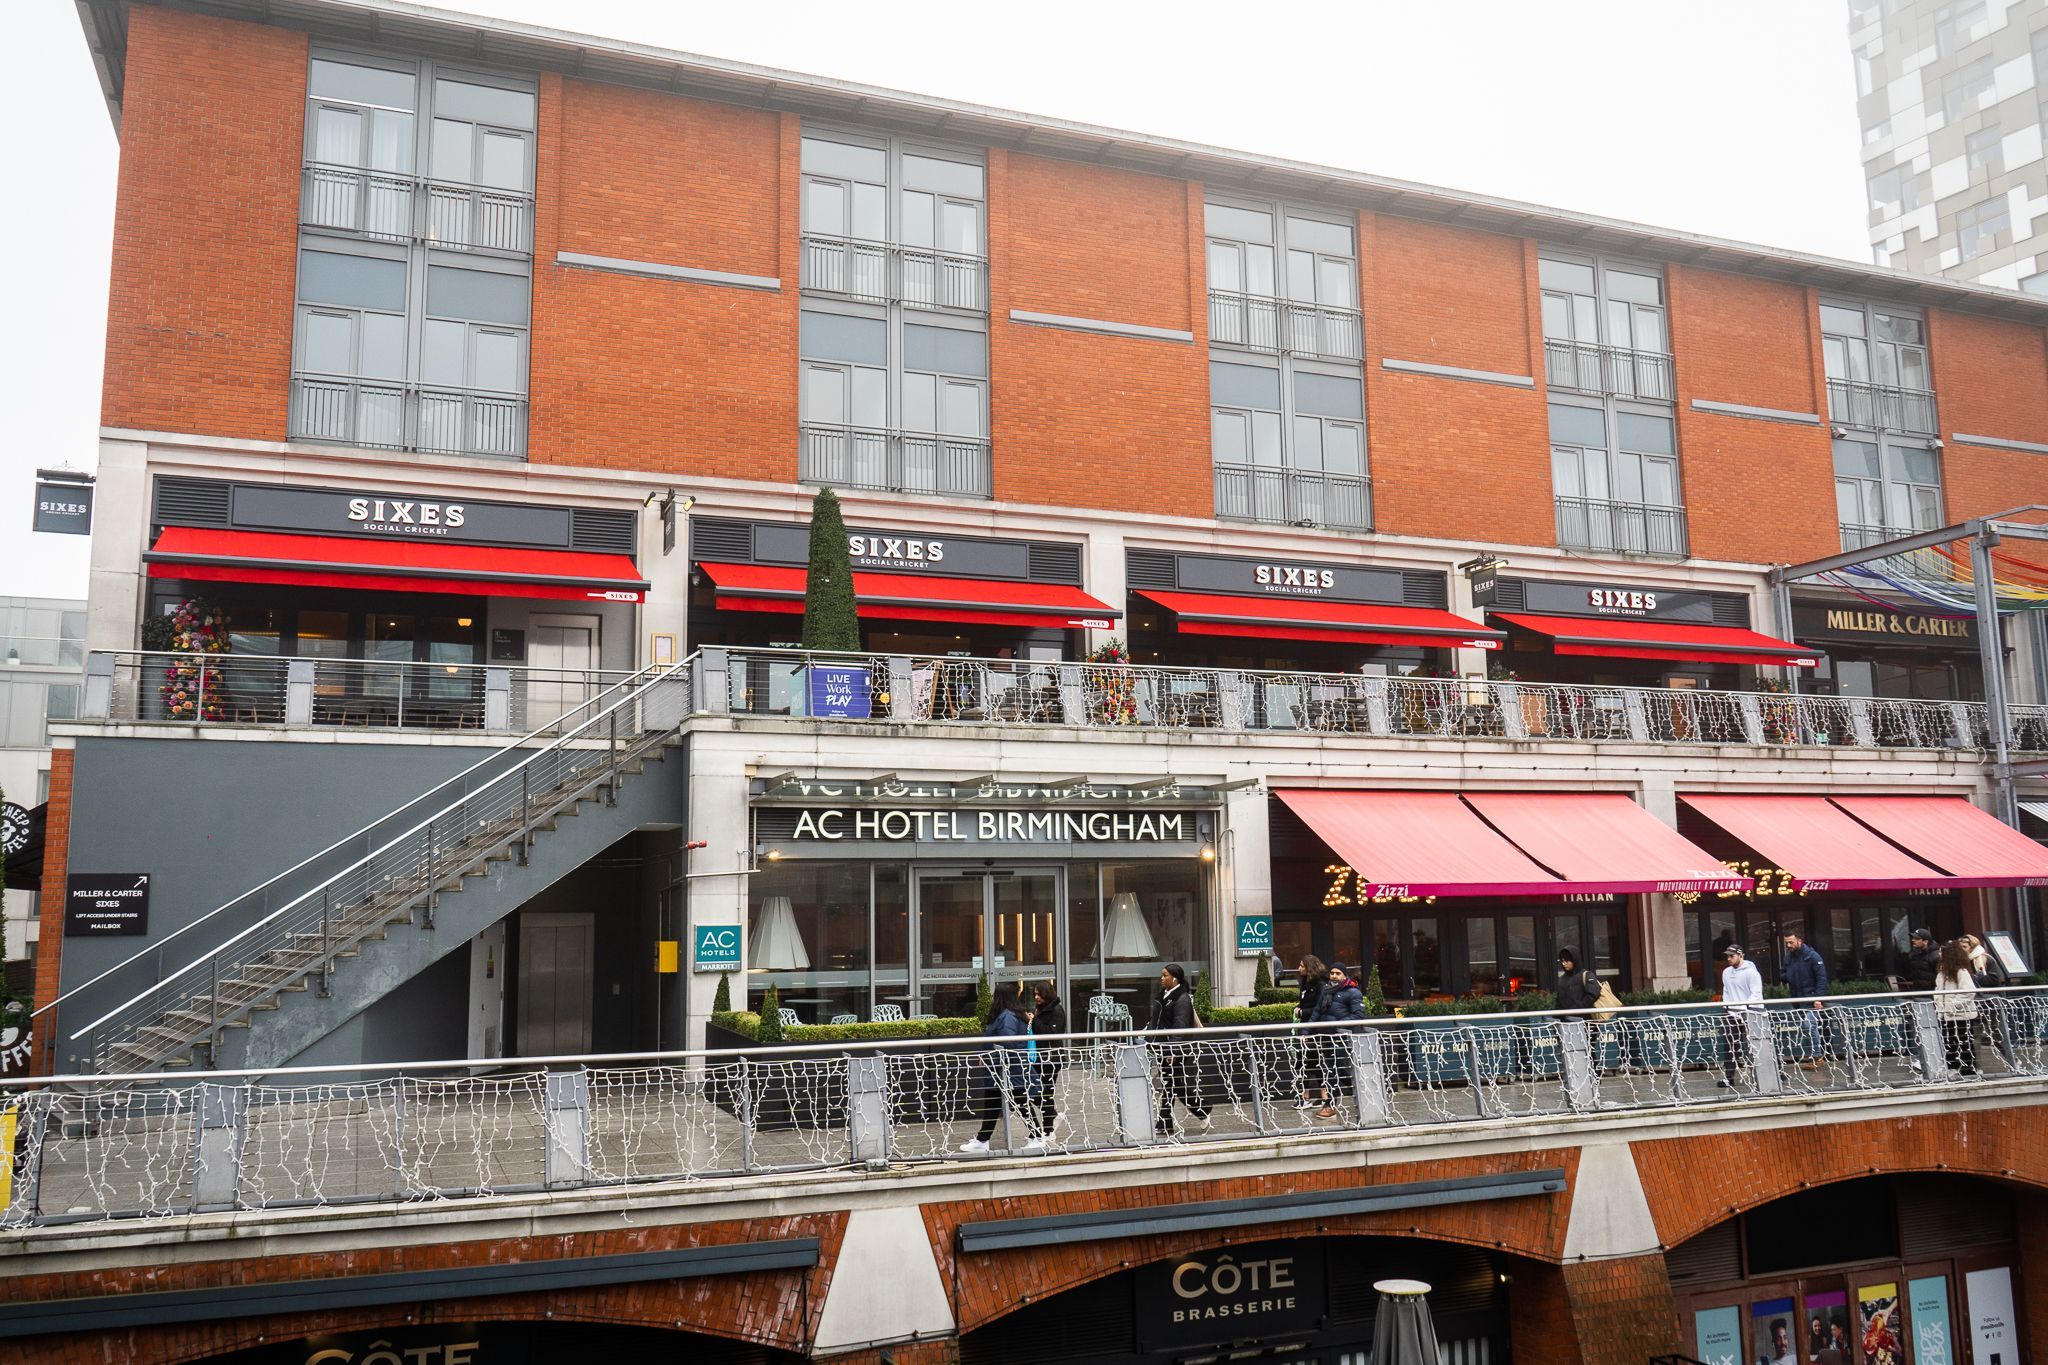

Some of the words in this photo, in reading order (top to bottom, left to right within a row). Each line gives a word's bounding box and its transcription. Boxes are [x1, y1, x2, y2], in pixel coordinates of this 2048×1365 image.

[40, 501, 87, 514] SIXES
[347, 498, 465, 528] SIXES
[363, 523, 400, 532] SOCIAL
[404, 526, 448, 535] CRICKET
[848, 535, 944, 562] SIXES
[860, 558, 891, 566] SOCIAL
[893, 560, 929, 568] CRICKET
[1255, 565, 1334, 589] SIXES
[1265, 585, 1291, 593] SOCIAL
[1292, 587, 1322, 595] CRICKET
[1474, 579, 1495, 592] SIXES
[1590, 589, 1657, 610] SIXES
[1827, 609, 1888, 633] MILLER
[1890, 614, 1907, 634] &
[1905, 615, 1969, 637] CARTER
[827, 674, 850, 684] LIVE
[826, 684, 852, 695] Work
[825, 694, 852, 708] PLAY
[793, 810, 843, 839] AC
[855, 810, 968, 840] HOTEL
[978, 811, 1182, 841] BIRMINGHAM
[1375, 884, 1409, 897] Zizzi
[1656, 881, 1701, 892] INDIVIDUALLY
[1703, 880, 1743, 890] ITALIAN
[1801, 880, 1829, 891] Zizzi
[73, 890, 104, 898] MILLER
[95, 900, 120, 908] SIXES
[1241, 920, 1268, 937] AC
[701, 930, 735, 948] AC
[1172, 1254, 1295, 1299] CÔTE
[1173, 1297, 1296, 1323] BRASSERIE
